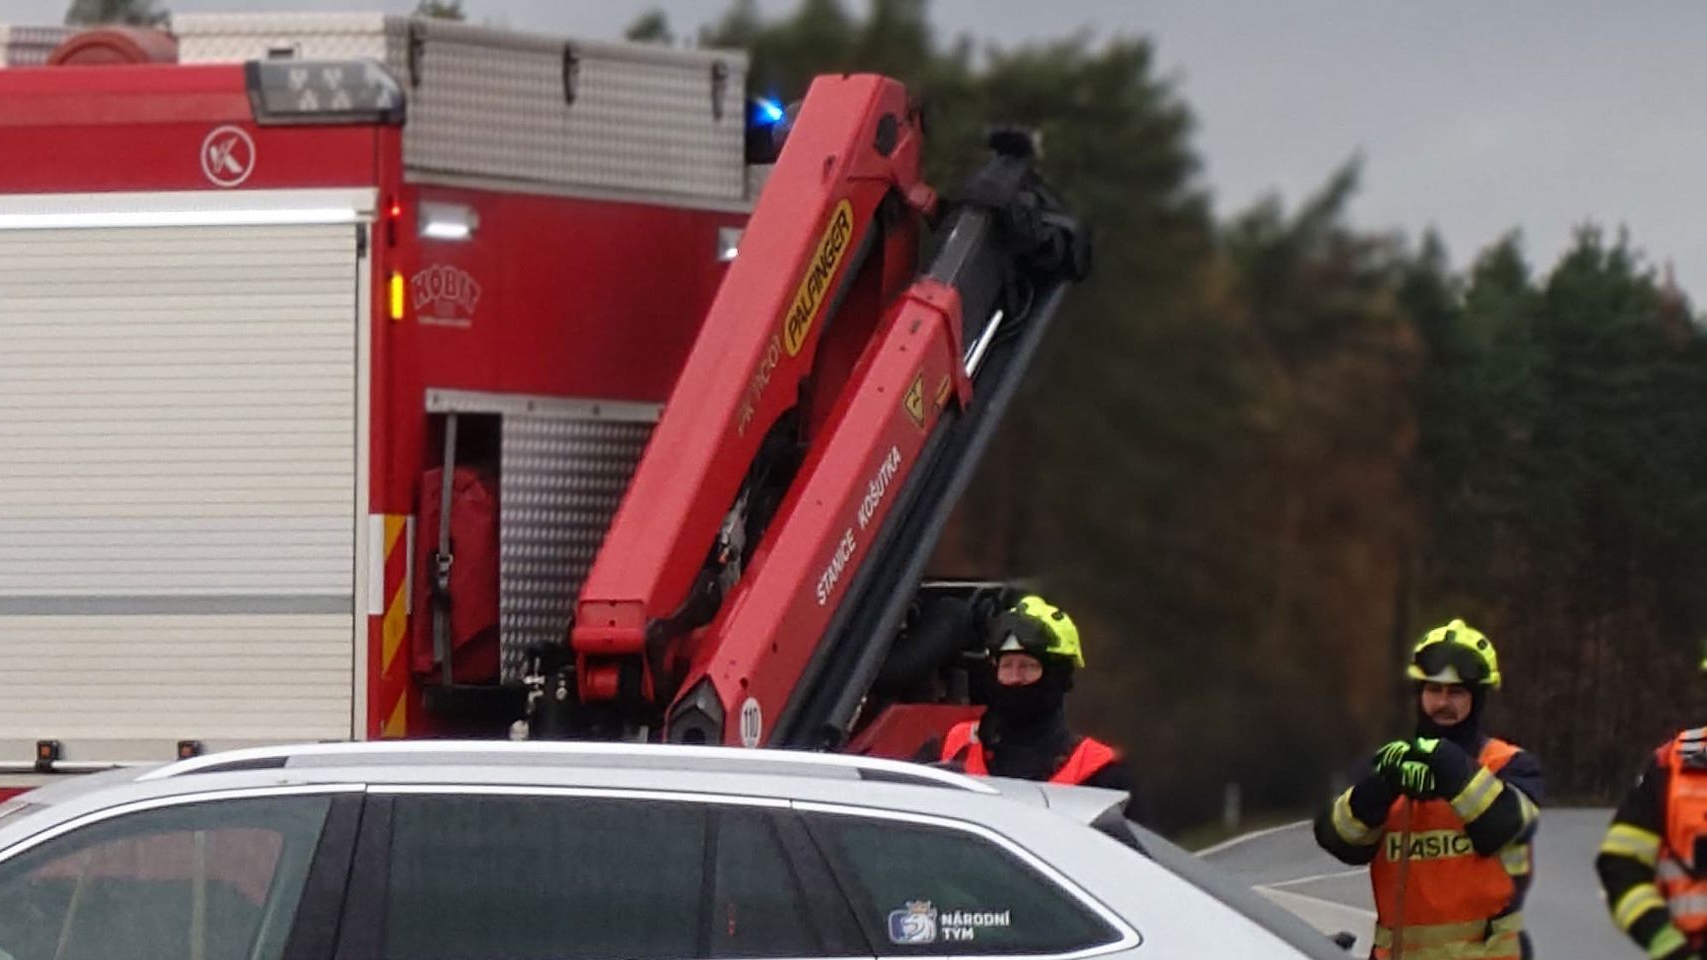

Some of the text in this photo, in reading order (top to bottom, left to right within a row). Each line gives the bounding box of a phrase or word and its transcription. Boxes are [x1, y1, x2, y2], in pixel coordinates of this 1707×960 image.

[817, 445, 902, 606] STANICE KOŠUTKA
[941, 909, 1011, 927] NÁRODNÍ
